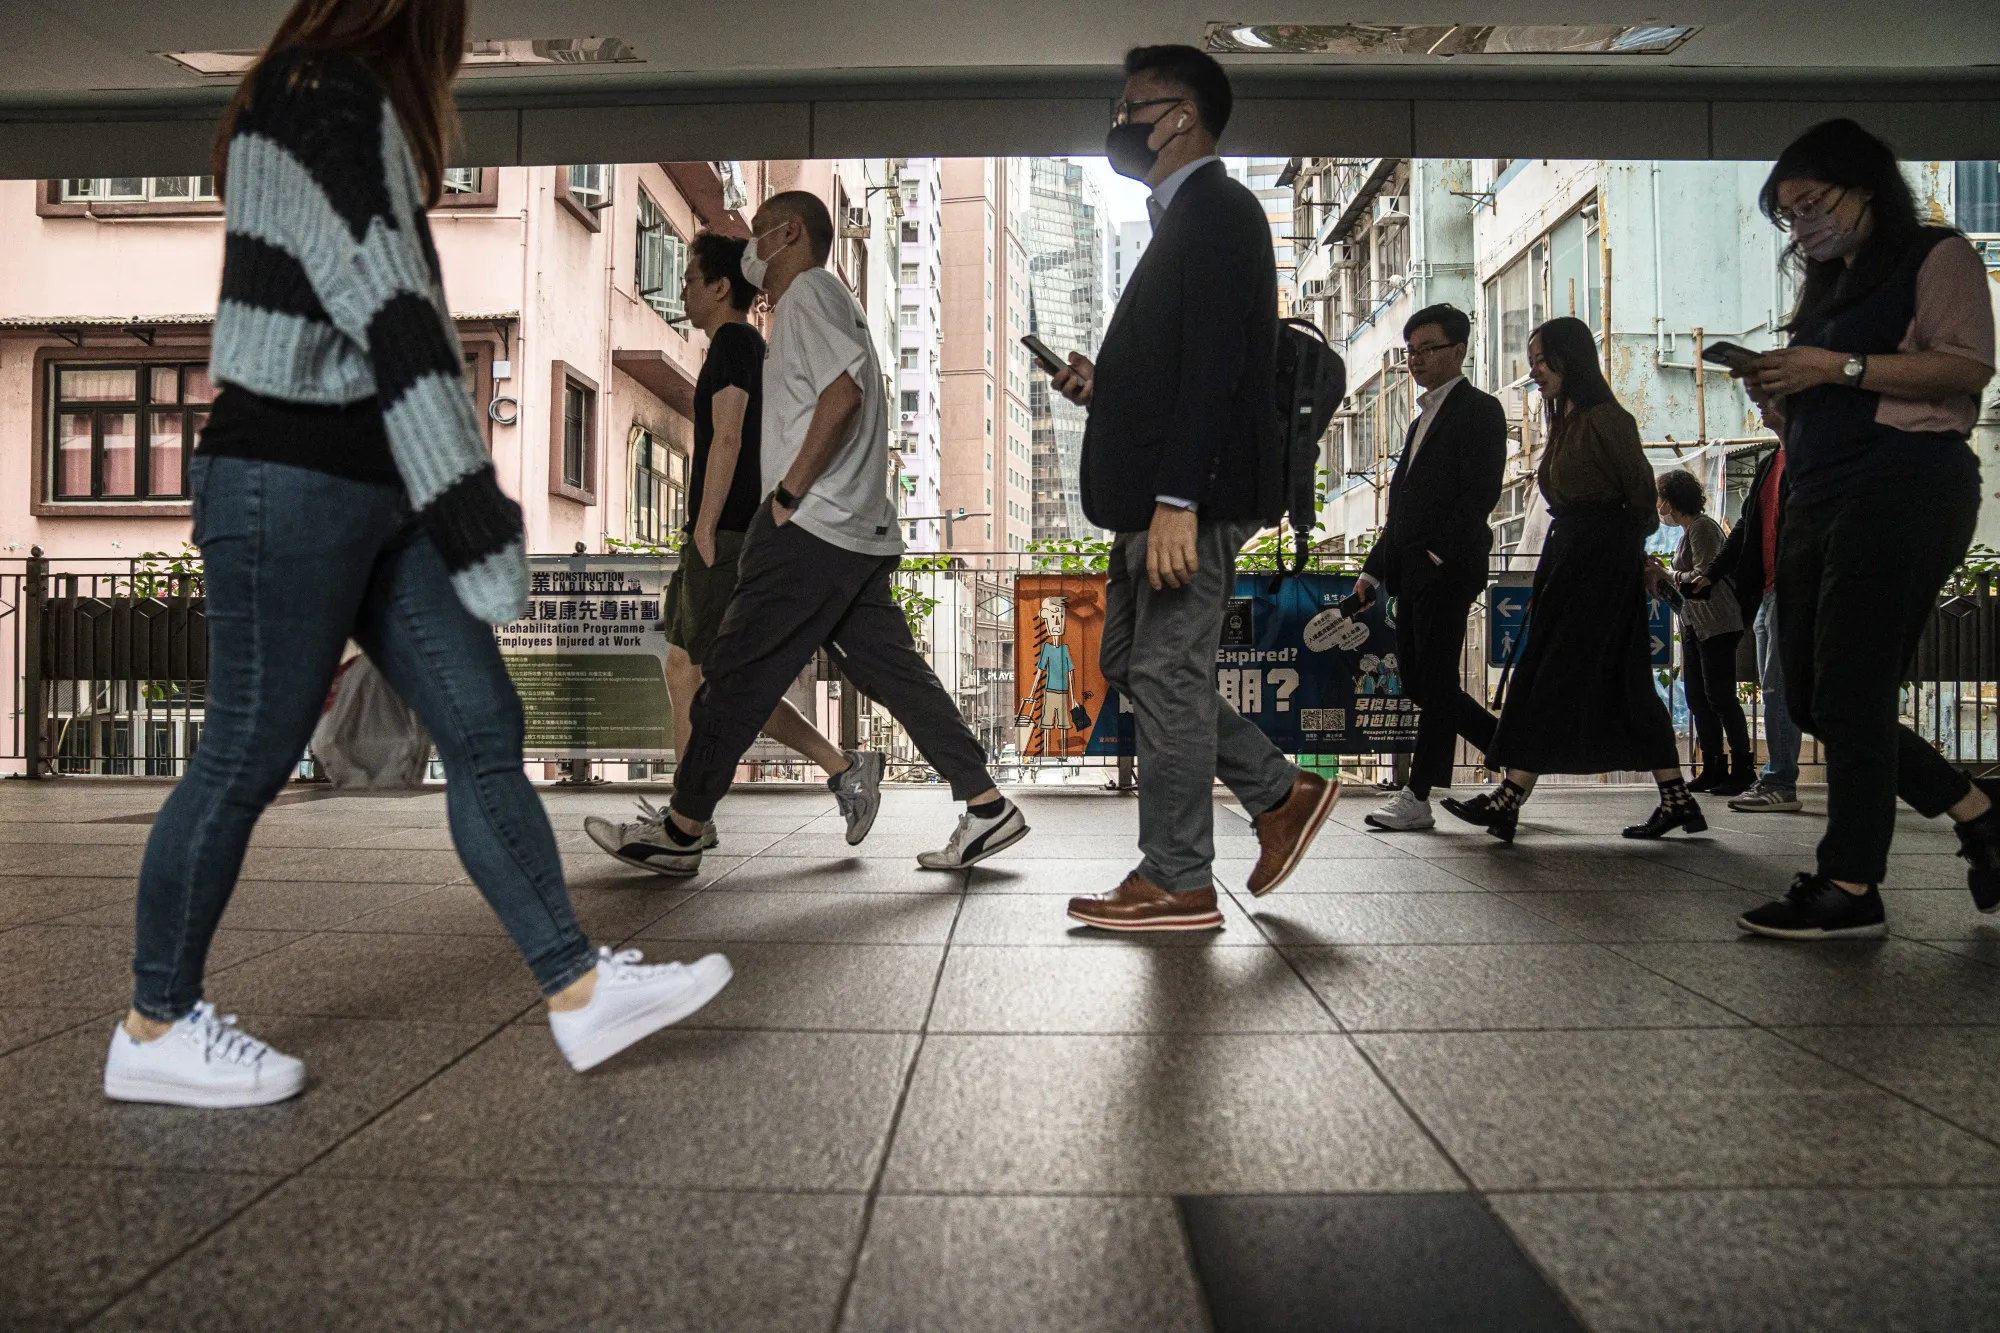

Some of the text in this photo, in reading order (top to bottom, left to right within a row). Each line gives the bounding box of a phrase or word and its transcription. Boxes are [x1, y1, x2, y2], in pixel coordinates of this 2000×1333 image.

[532, 572, 550, 592] 業
[552, 572, 624, 582] CONSTRUCTION
[552, 582, 624, 592] INDUSTRY
[503, 623, 579, 634] Rehabilitation
[583, 623, 645, 635] Programme
[496, 636, 641, 648] Employees Injured at Work
[1216, 648, 1298, 666] Expired?
